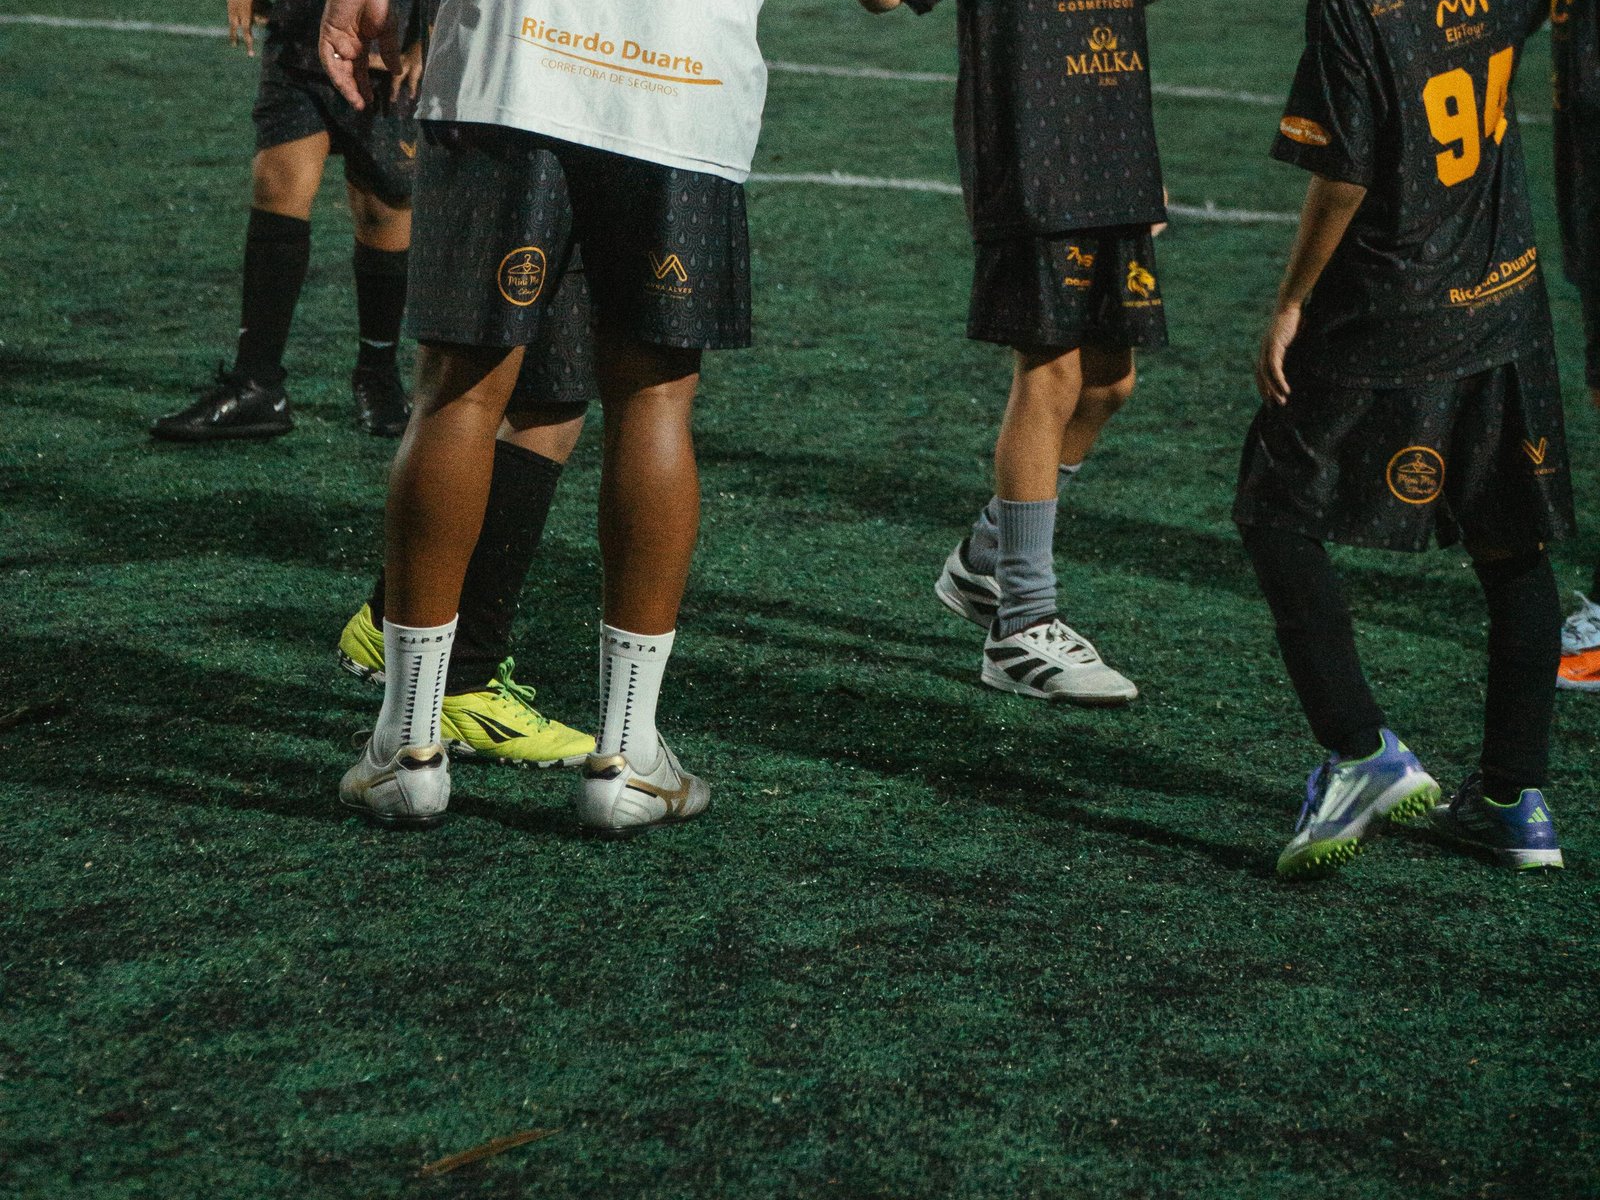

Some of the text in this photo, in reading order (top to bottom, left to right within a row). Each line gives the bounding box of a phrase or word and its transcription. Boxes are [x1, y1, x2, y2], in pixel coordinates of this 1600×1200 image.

[1445, 22, 1487, 43] EliTour
[521, 16, 704, 76] Ricardo Duarte
[1066, 51, 1144, 76] MALKA
[541, 56, 679, 97] CORRETORA DE SEGUROS
[400, 631, 455, 644] KIPST
